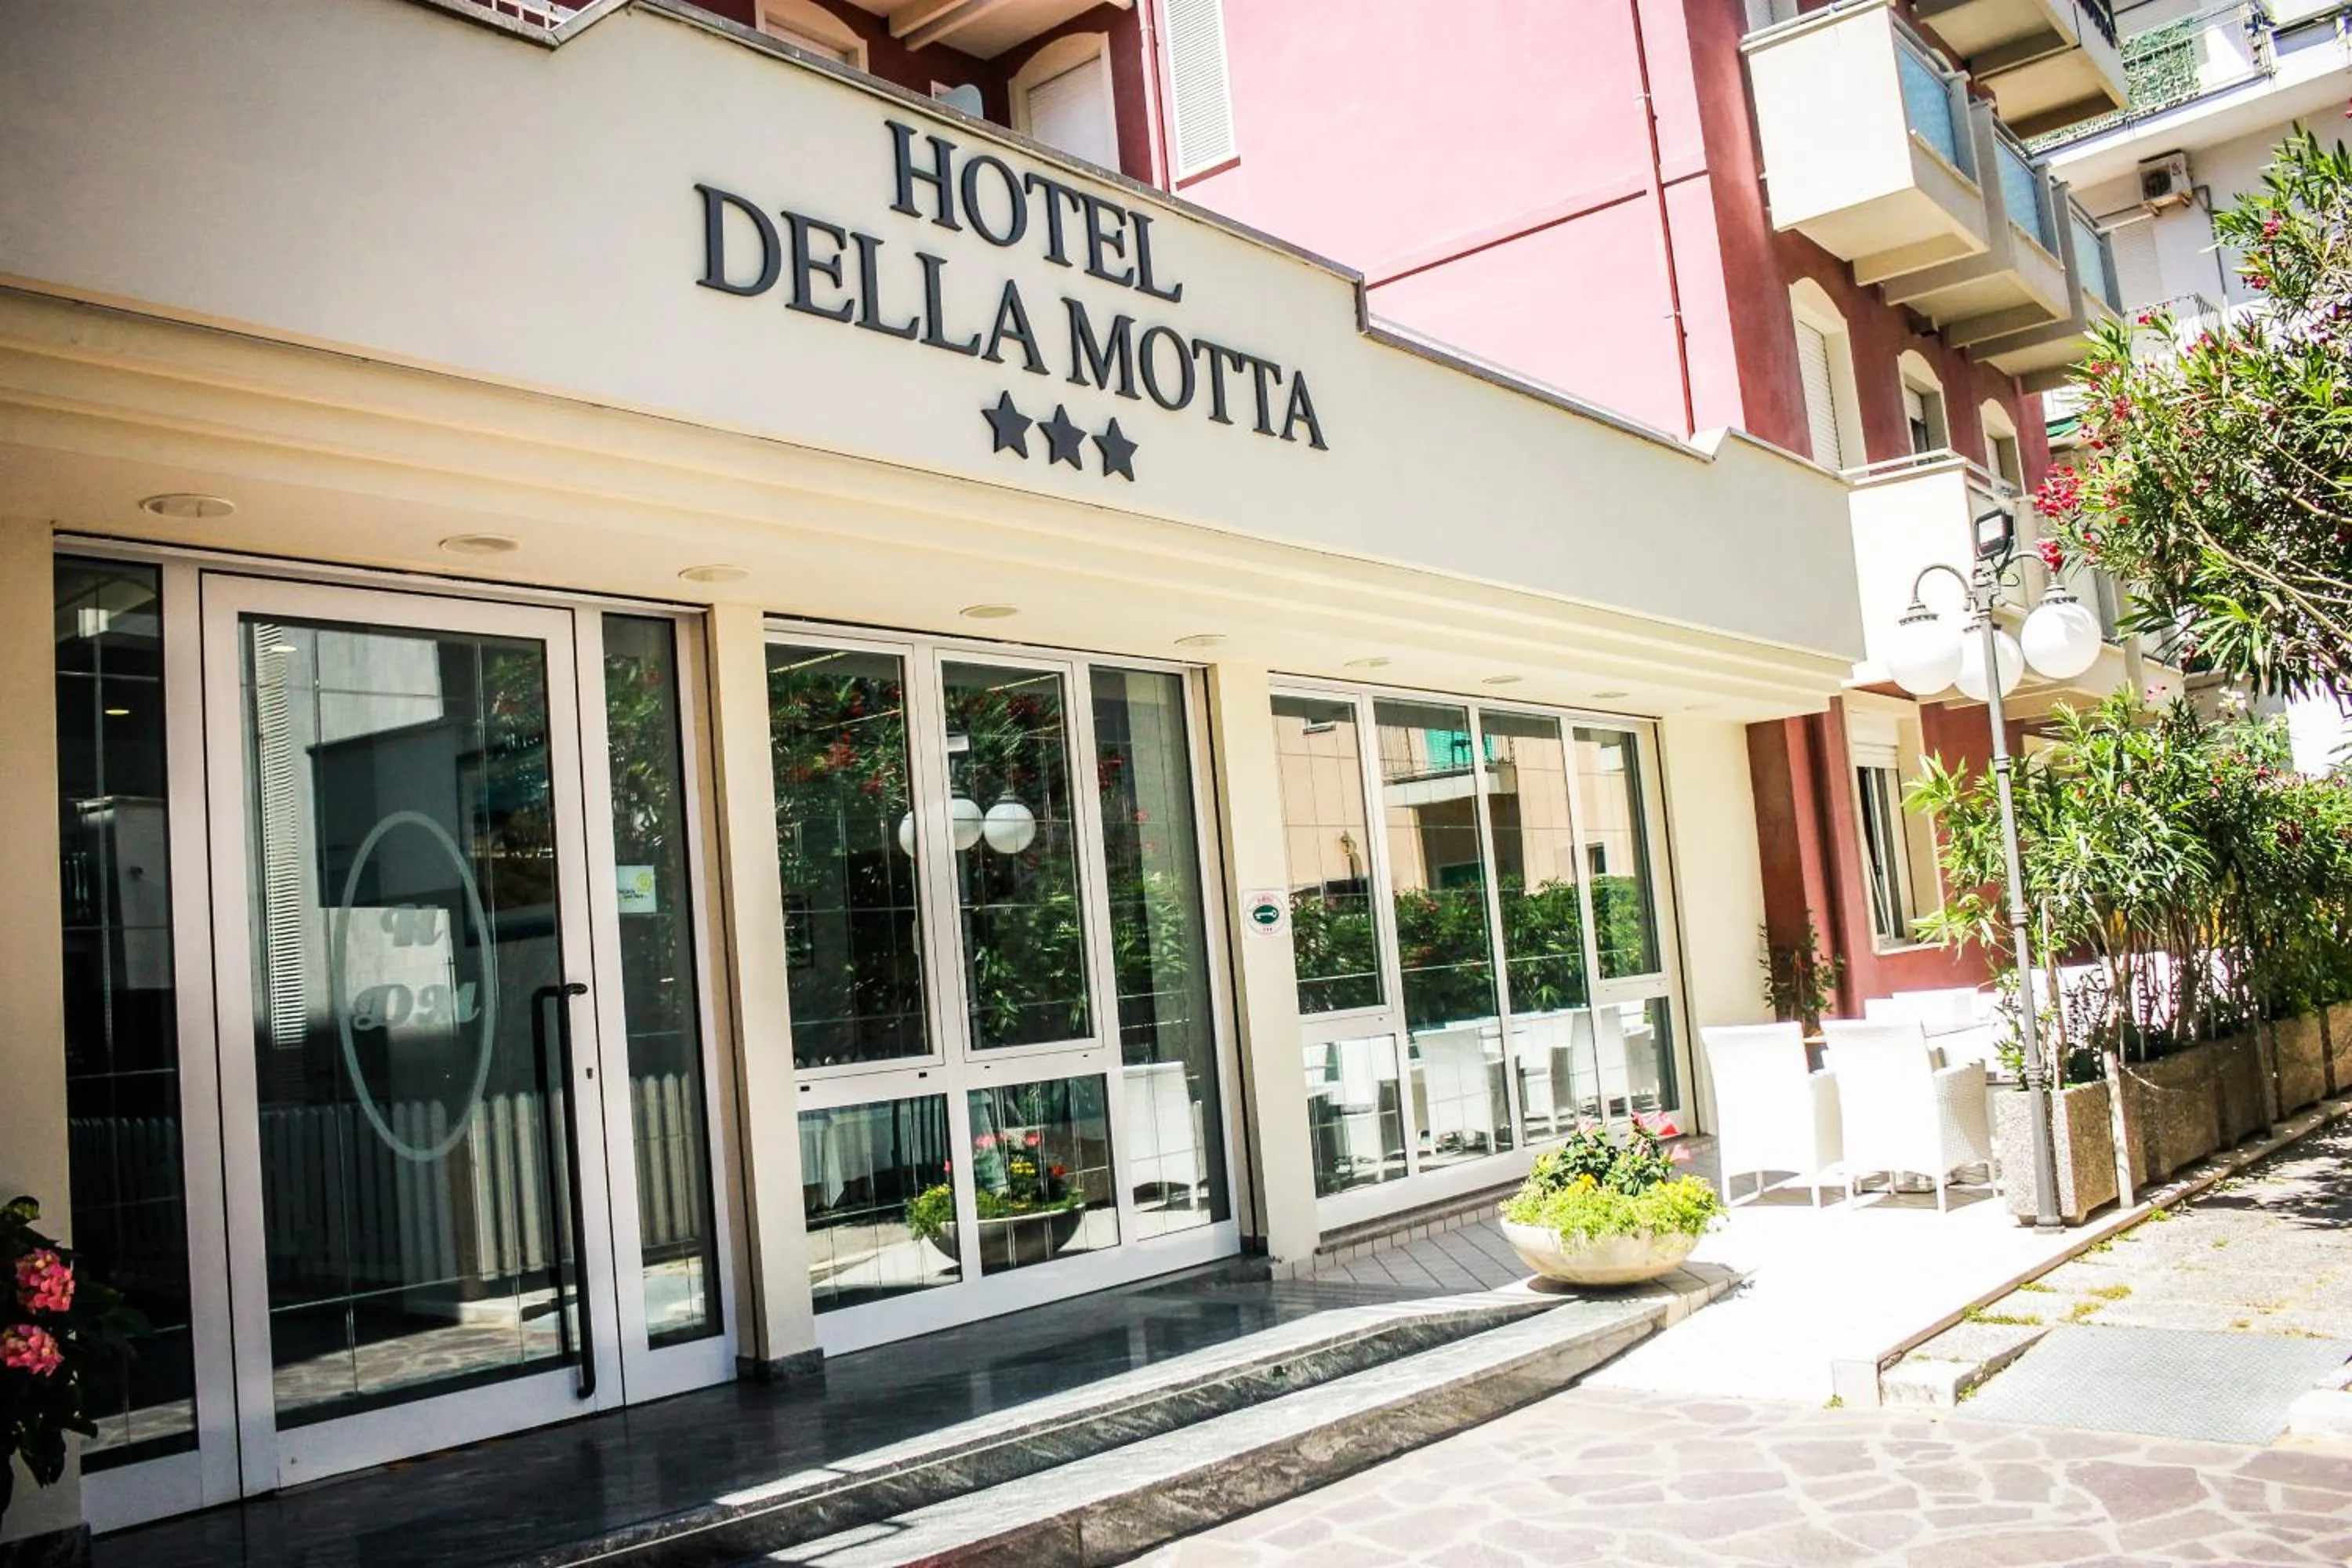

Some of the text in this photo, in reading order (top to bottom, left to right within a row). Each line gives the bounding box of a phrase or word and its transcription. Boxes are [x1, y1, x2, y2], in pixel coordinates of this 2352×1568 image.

[693, 183, 1329, 451] DELLA MOTTA
[884, 119, 1183, 303] HOTEL
